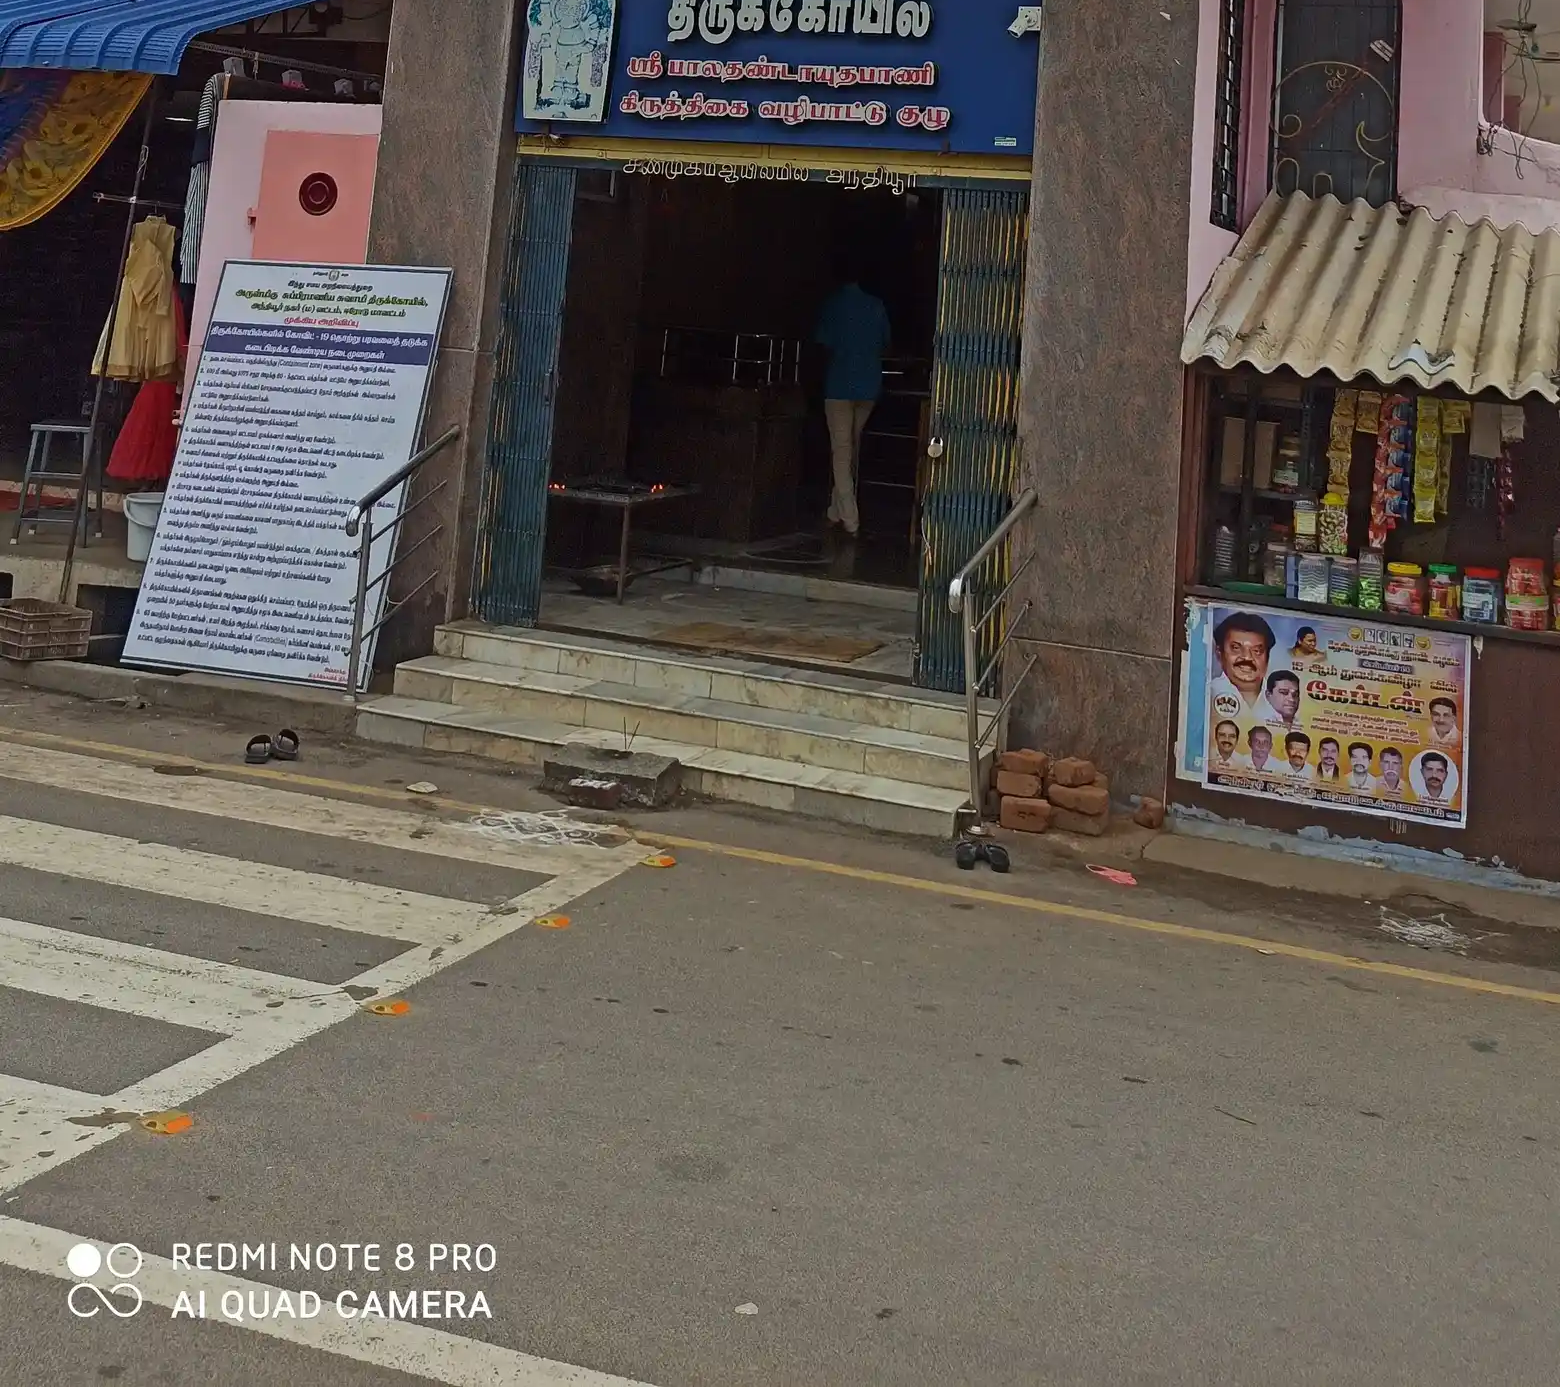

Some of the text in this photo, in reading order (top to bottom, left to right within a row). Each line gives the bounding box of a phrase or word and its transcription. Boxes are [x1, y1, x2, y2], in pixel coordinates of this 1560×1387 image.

[627, 50, 663, 79] ஸ்ரீ
[619, 90, 951, 131] கிருத்திகை வழிபாட்டு குழு
